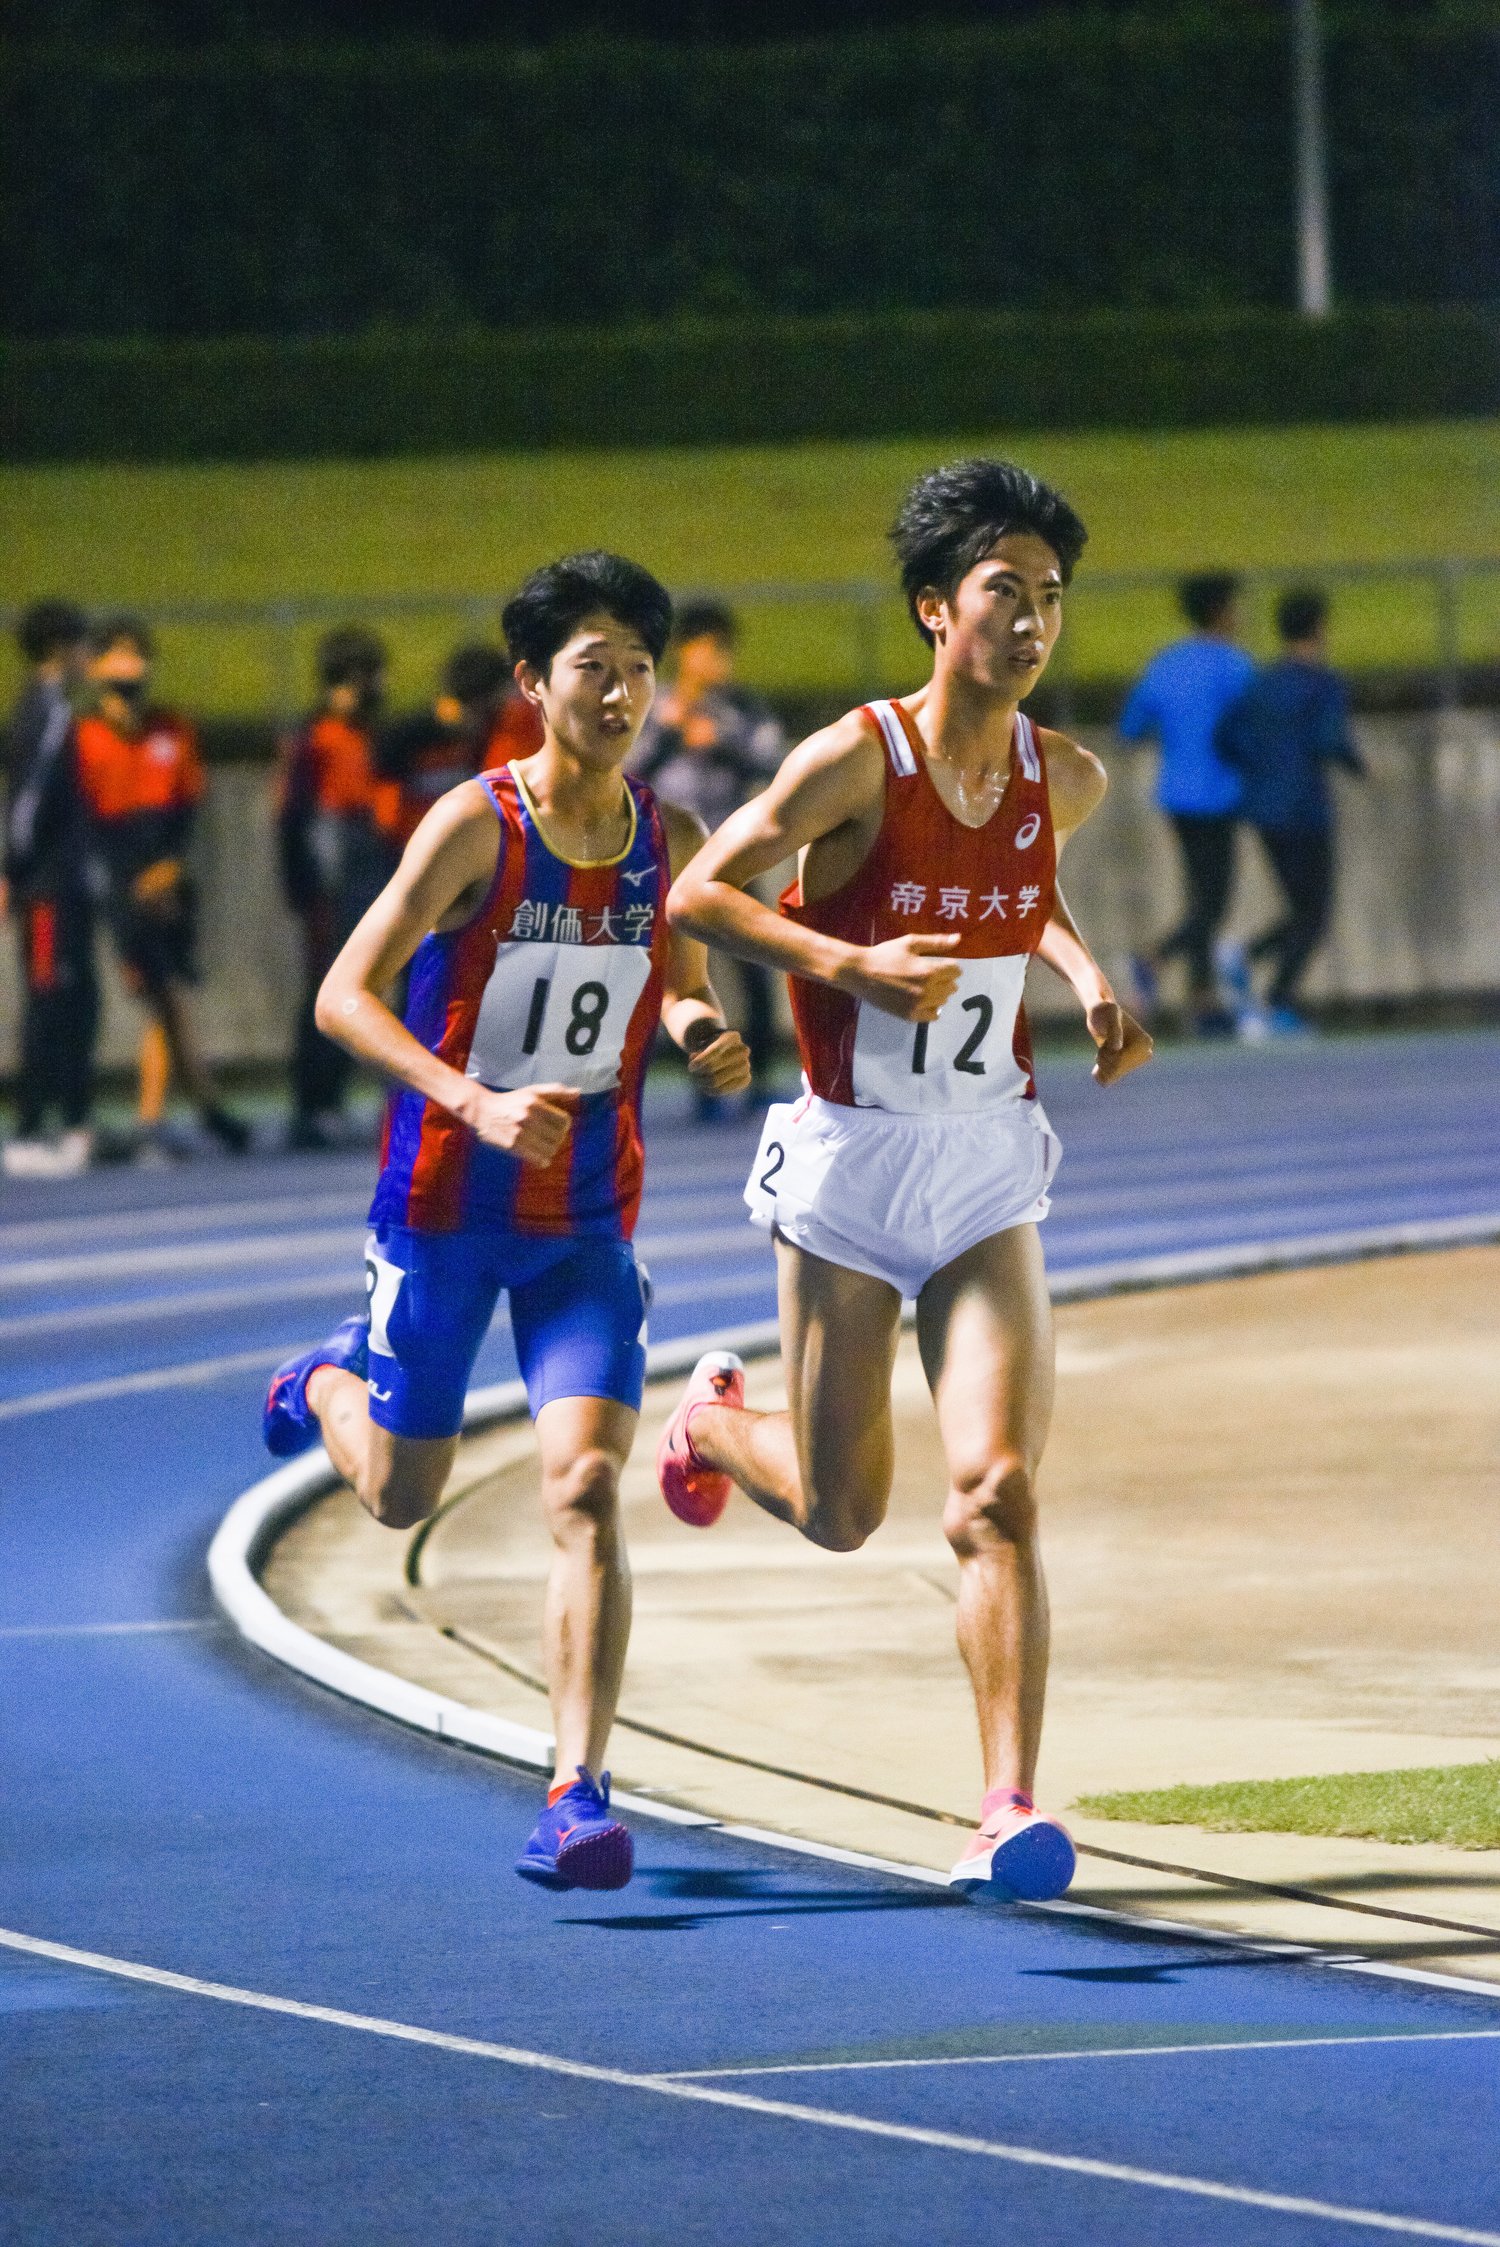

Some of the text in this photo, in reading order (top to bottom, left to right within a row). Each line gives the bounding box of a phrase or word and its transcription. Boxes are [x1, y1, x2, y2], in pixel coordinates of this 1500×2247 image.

[509, 898, 655, 943] 創価大学
[890, 880, 1040, 920] 帝京大学
[522, 979, 609, 1056] 18
[760, 1141, 785, 1197] 2
